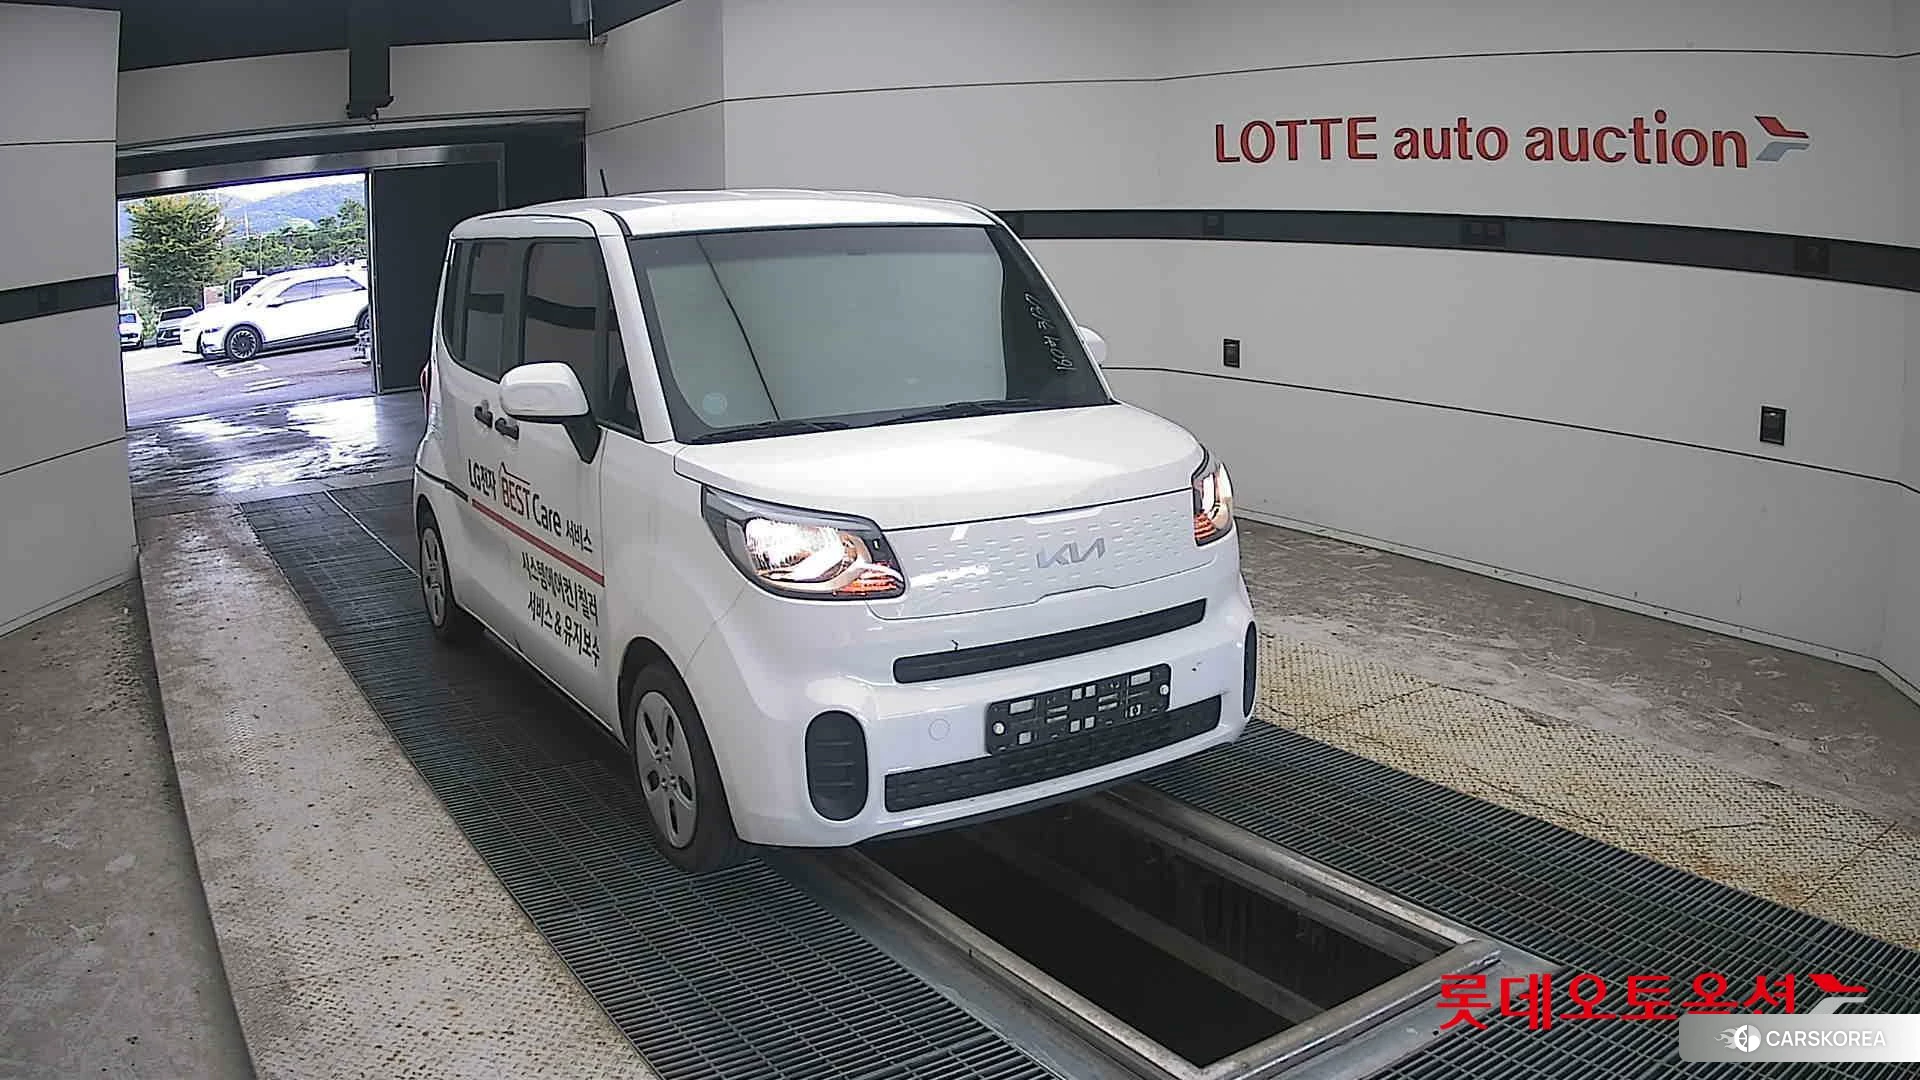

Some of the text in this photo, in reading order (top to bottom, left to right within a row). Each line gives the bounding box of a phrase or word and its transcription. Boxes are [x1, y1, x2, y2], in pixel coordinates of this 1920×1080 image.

[1214, 108, 1749, 169] LOTTE auto auction
[467, 457, 593, 554] LG전자 BEST Care 서비스
